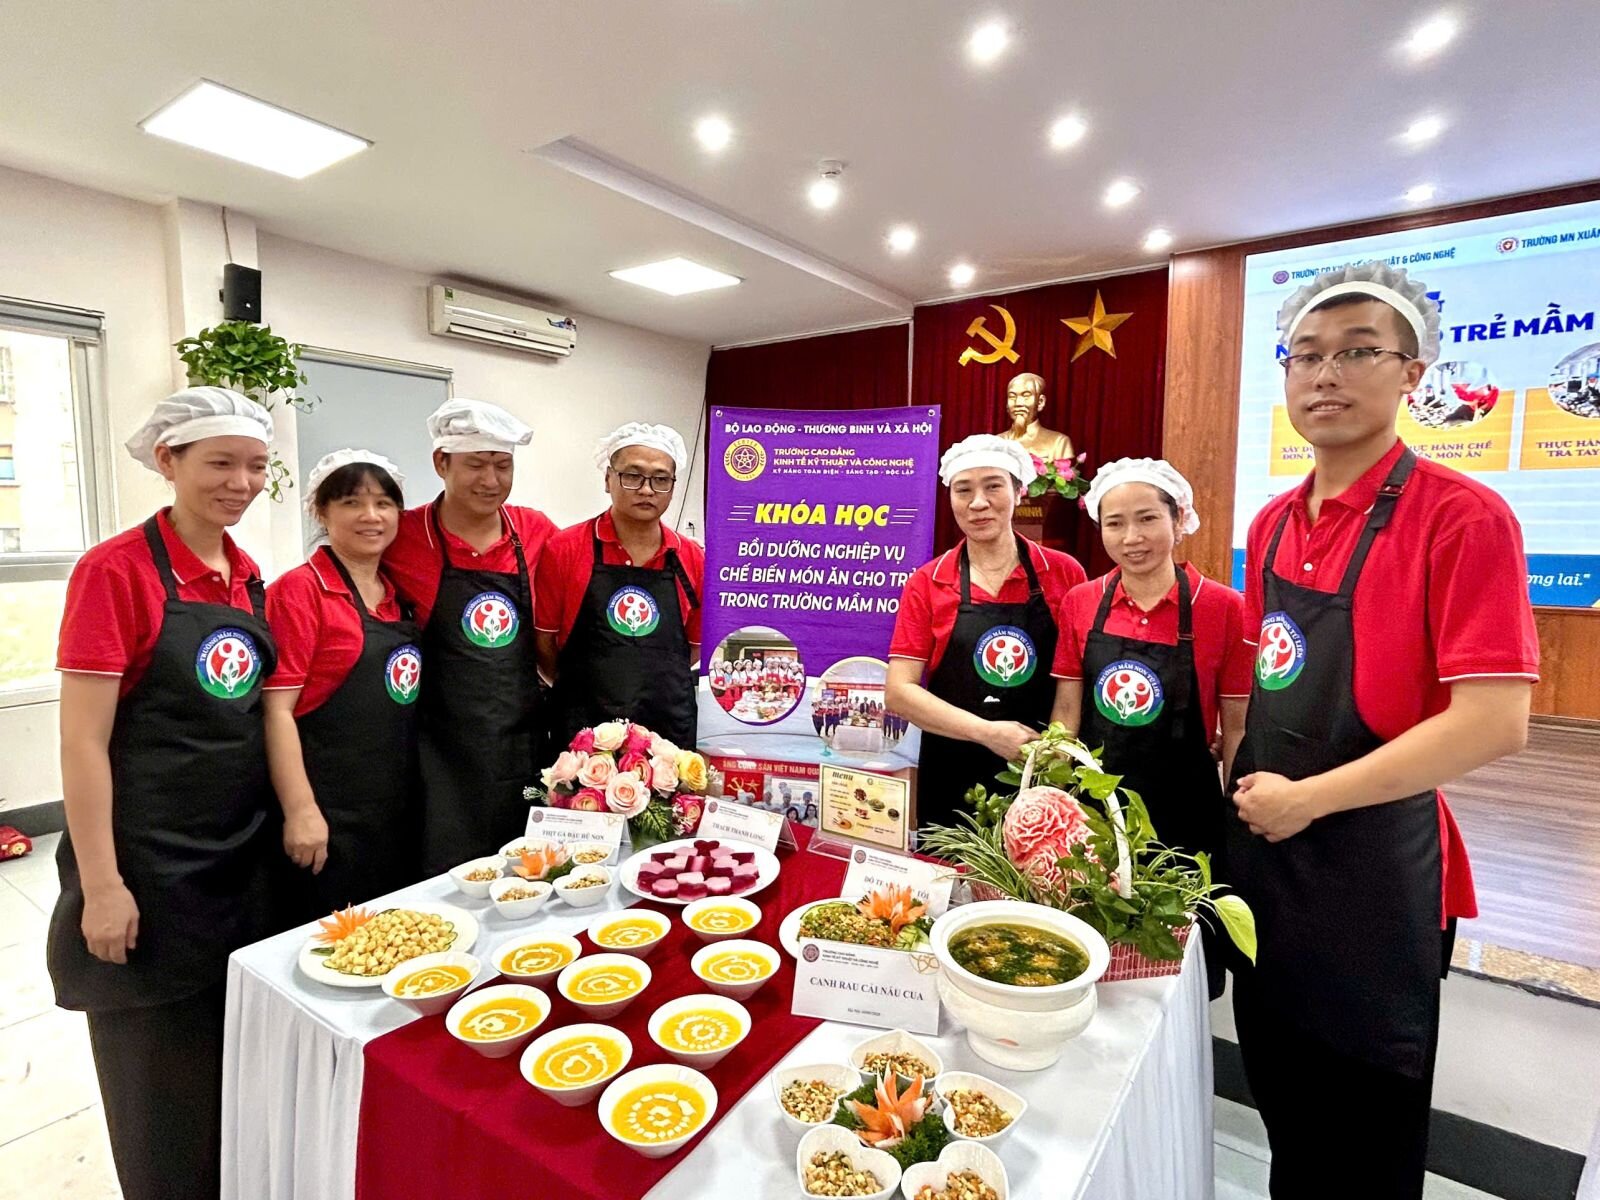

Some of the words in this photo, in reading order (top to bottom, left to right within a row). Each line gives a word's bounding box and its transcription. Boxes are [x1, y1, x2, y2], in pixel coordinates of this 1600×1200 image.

[1521, 235, 1558, 248] TRƯỜNG
[1560, 232, 1575, 243] MN
[1409, 252, 1432, 263] CÔNG
[1433, 247, 1456, 259] NGHỆ
[1450, 313, 1507, 343] TRẺ
[1513, 302, 1594, 337] MẦM
[725, 421, 740, 435] BỘ
[742, 424, 762, 433] LAO
[764, 422, 795, 435] ĐỘNG
[804, 423, 847, 434] THƯƠNG
[849, 425, 874, 434] BINH
[877, 423, 892, 434] VÀ
[894, 423, 910, 434] XÃ
[912, 421, 932, 435] HỘI
[774, 447, 810, 456] TRƯỜNG
[830, 446, 855, 456] ĐẲNG
[1432, 443, 1464, 451] HÀNH
[796, 456, 806, 466] TẾ
[807, 457, 819, 466] KỸ
[820, 457, 848, 468] THUẬT
[849, 458, 862, 466] VÀ
[863, 457, 888, 466] CÔNG
[889, 457, 914, 468] NGHỆ
[755, 499, 827, 525] KHÓA
[834, 504, 890, 531] HỌC
[738, 537, 764, 557] BỒI
[767, 539, 821, 559] DƯỠNG
[824, 541, 880, 563] NGHIỆP
[884, 545, 906, 564] VỤ
[719, 563, 751, 582] CHẾ
[752, 563, 786, 583] BIẾN
[789, 566, 824, 585] MÓN
[827, 567, 849, 586] ĂN
[852, 572, 885, 587] CHO
[889, 567, 916, 587] TR
[719, 592, 768, 608] TRONG
[772, 592, 832, 611] TRƯỜNG
[835, 592, 873, 613] MẦM
[876, 598, 900, 613] NO
[789, 766, 806, 774] NAM
[832, 771, 854, 781] menu
[810, 977, 837, 988] CANH
[840, 981, 859, 991] RAU
[903, 990, 924, 1001] CUA
